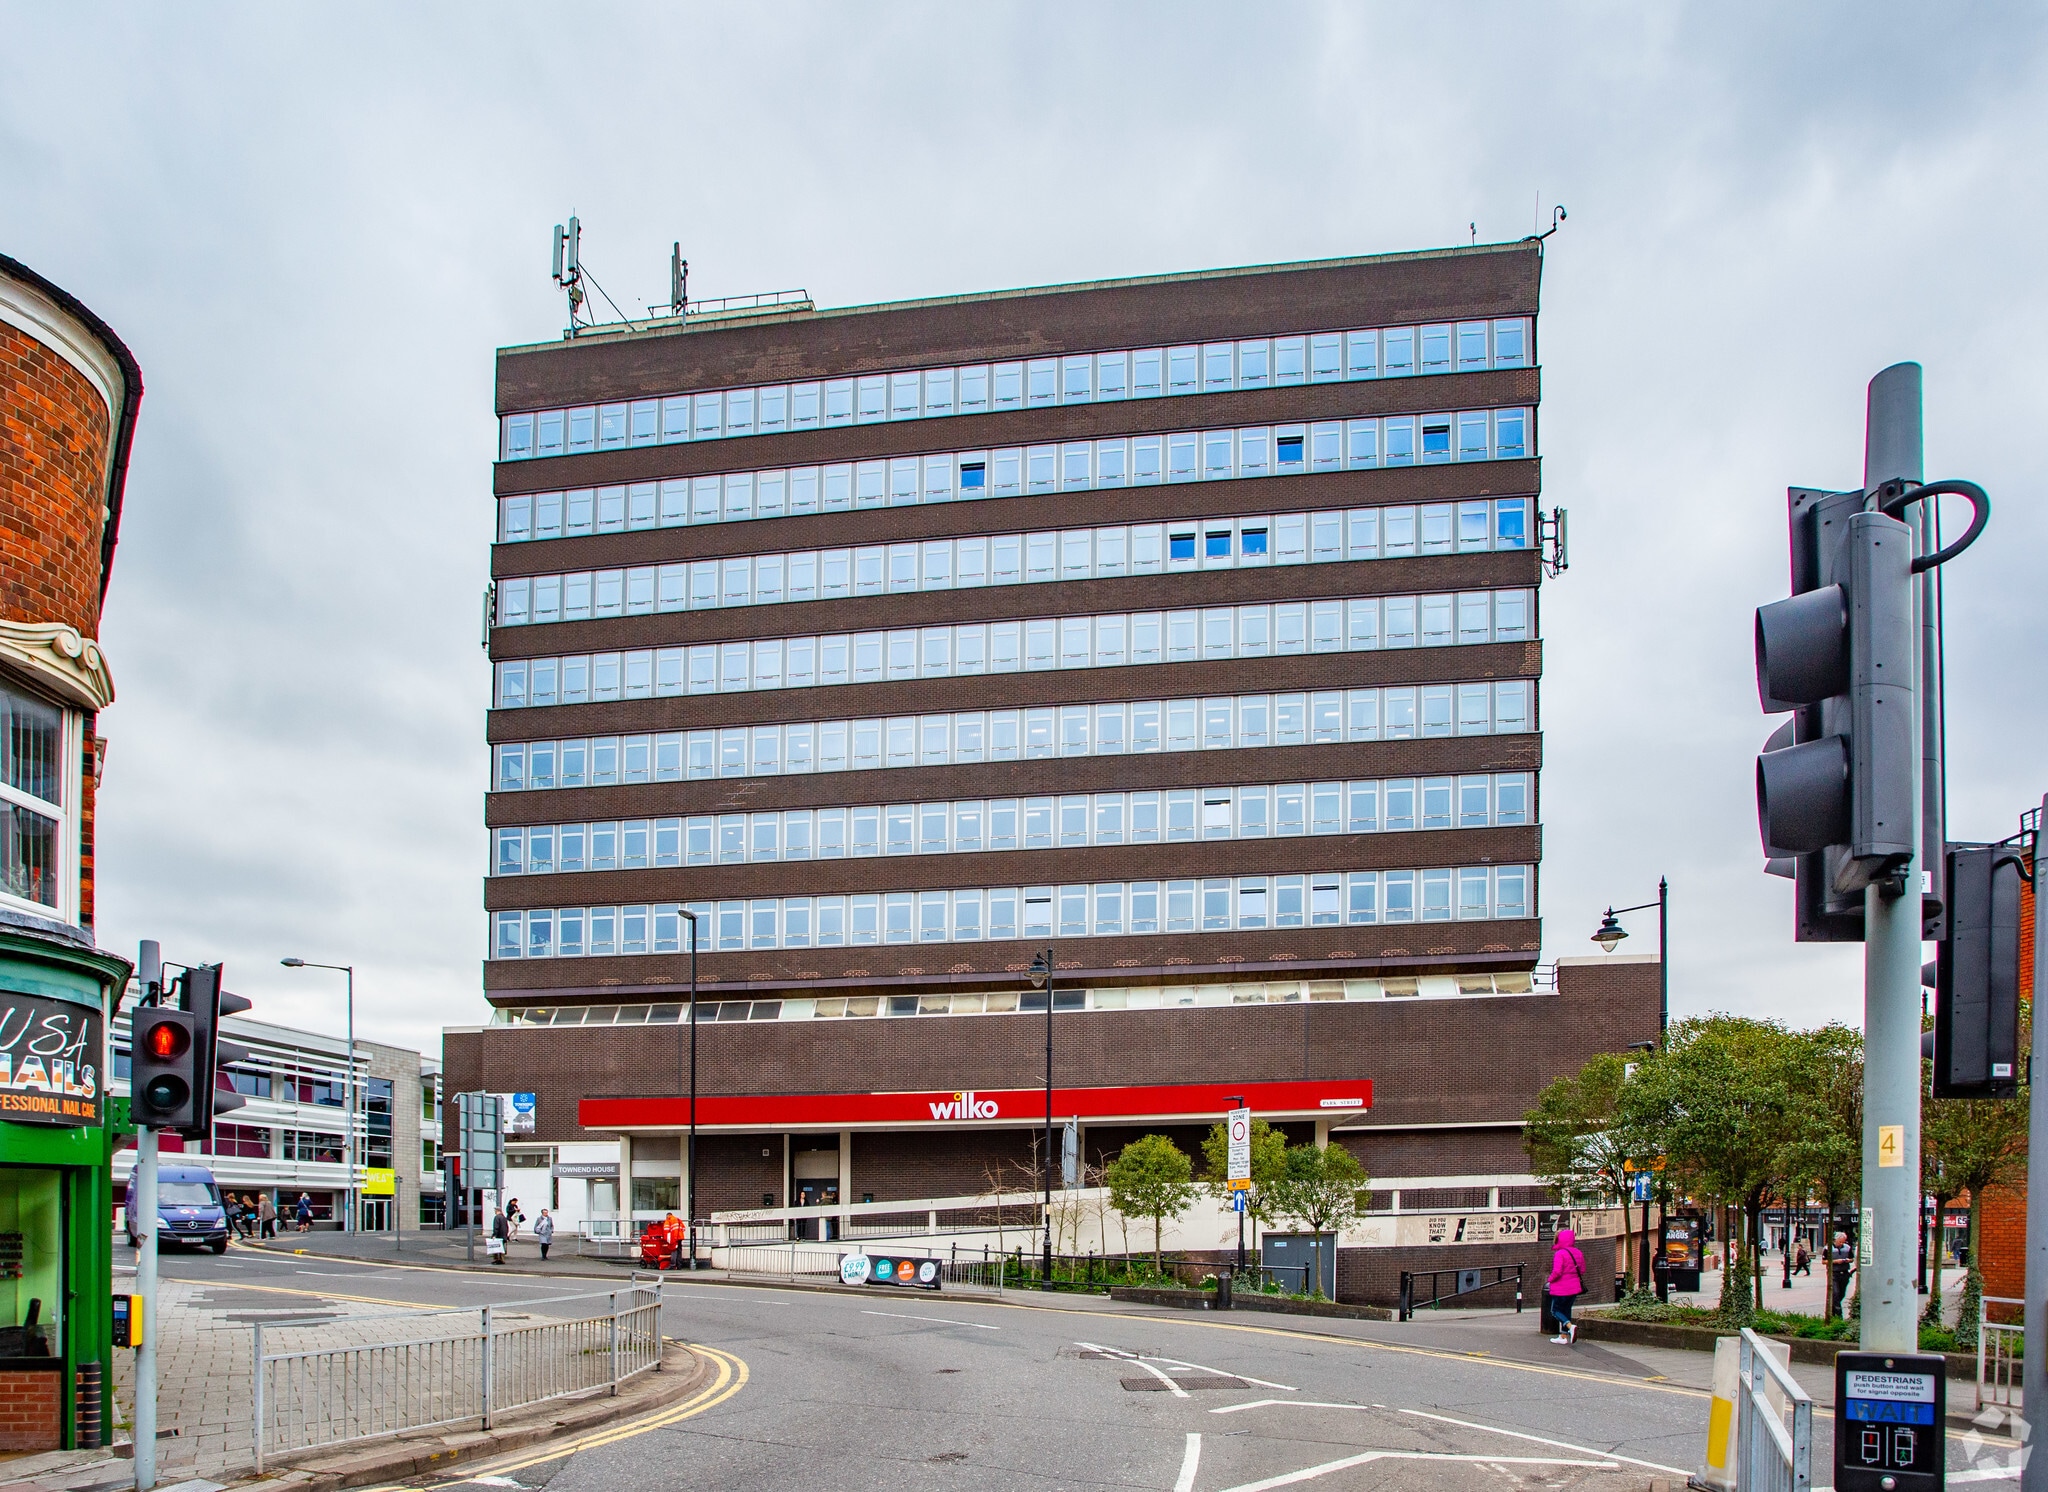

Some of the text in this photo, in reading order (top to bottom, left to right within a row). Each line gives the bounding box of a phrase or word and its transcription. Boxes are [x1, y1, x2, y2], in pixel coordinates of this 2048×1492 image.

[0, 1007, 88, 1071] USA
[62, 1099, 81, 1116] NAIL
[82, 1102, 96, 1119] CARE
[929, 1092, 999, 1120] wilko
[1881, 1132, 1896, 1154] 4
[1499, 1215, 1536, 1234] 320
[1550, 1214, 1561, 1232] 7
[1666, 1232, 1689, 1240] ANGUS
[844, 1261, 865, 1272] £9.99
[1855, 1374, 1923, 1385] PEDESTRIANS
[1853, 1401, 1924, 1422] WAIT
